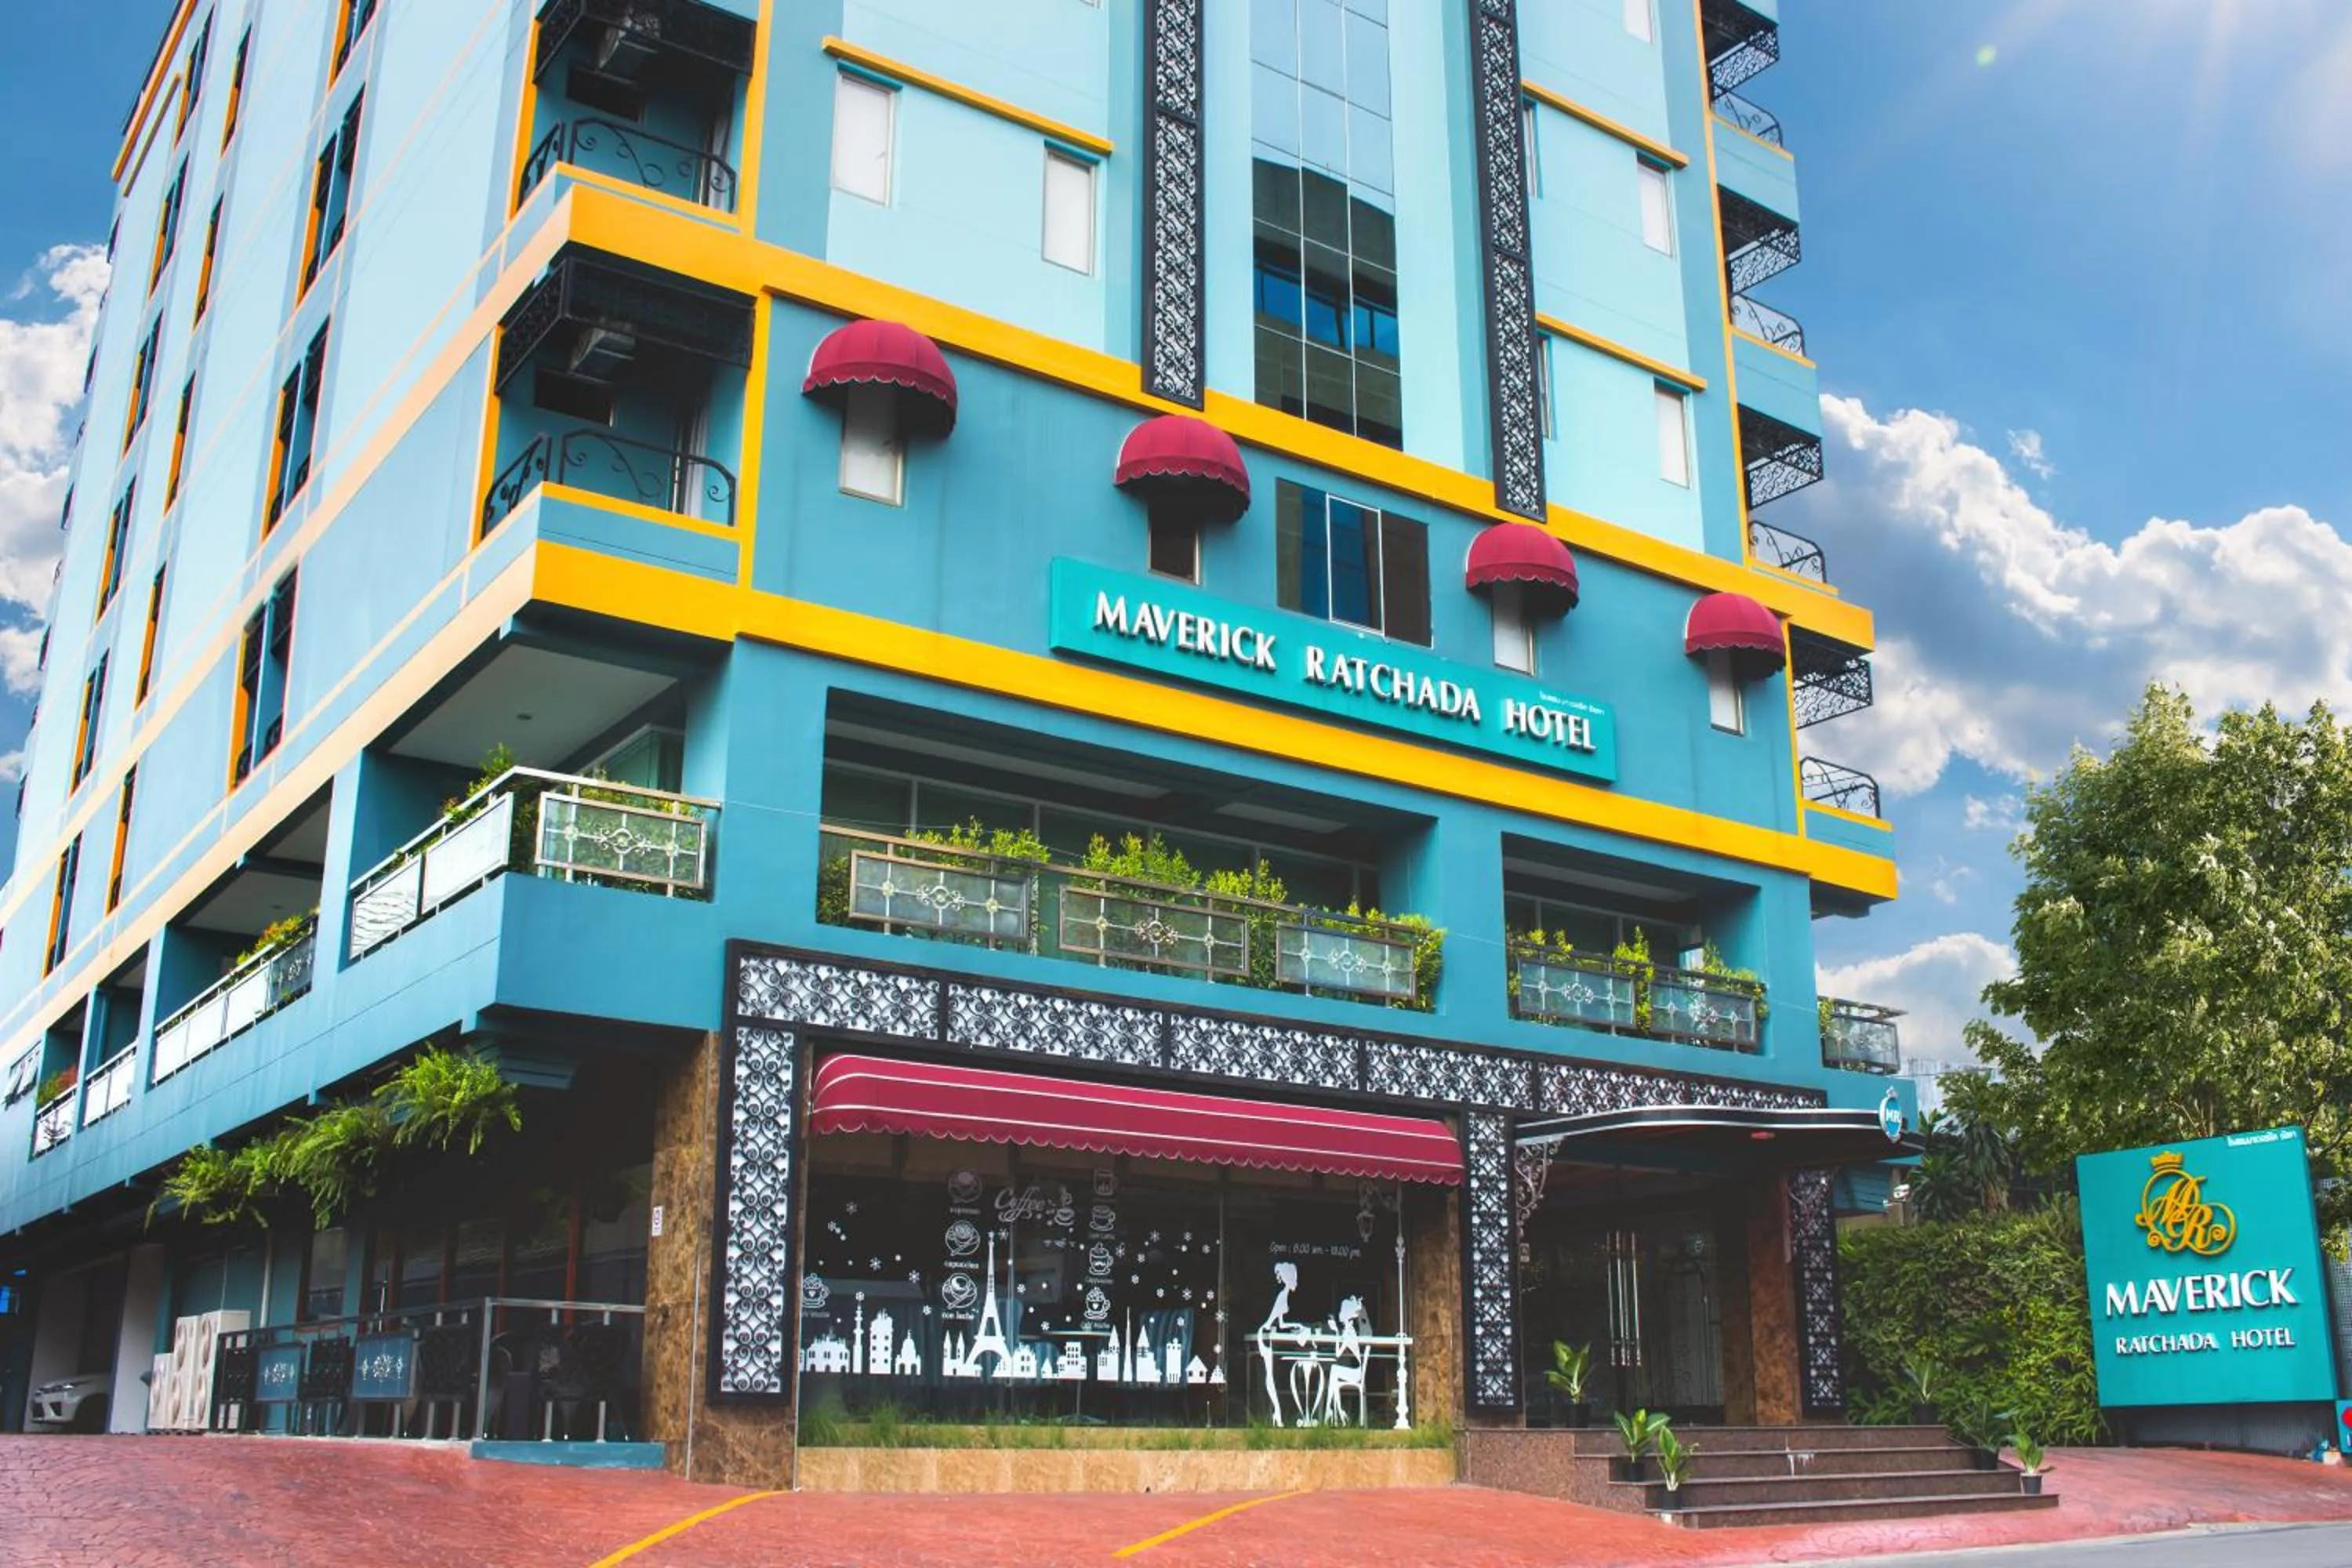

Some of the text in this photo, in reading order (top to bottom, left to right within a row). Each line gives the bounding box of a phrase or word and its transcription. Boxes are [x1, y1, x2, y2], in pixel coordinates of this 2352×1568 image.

[1094, 590, 1596, 752] MAVERICK RATCHADA HOTEL
[994, 1185, 1046, 1222] Coffee
[2106, 1267, 2299, 1317] MAVERICK
[2116, 1327, 2296, 1355] RATCHADA HOTEL
